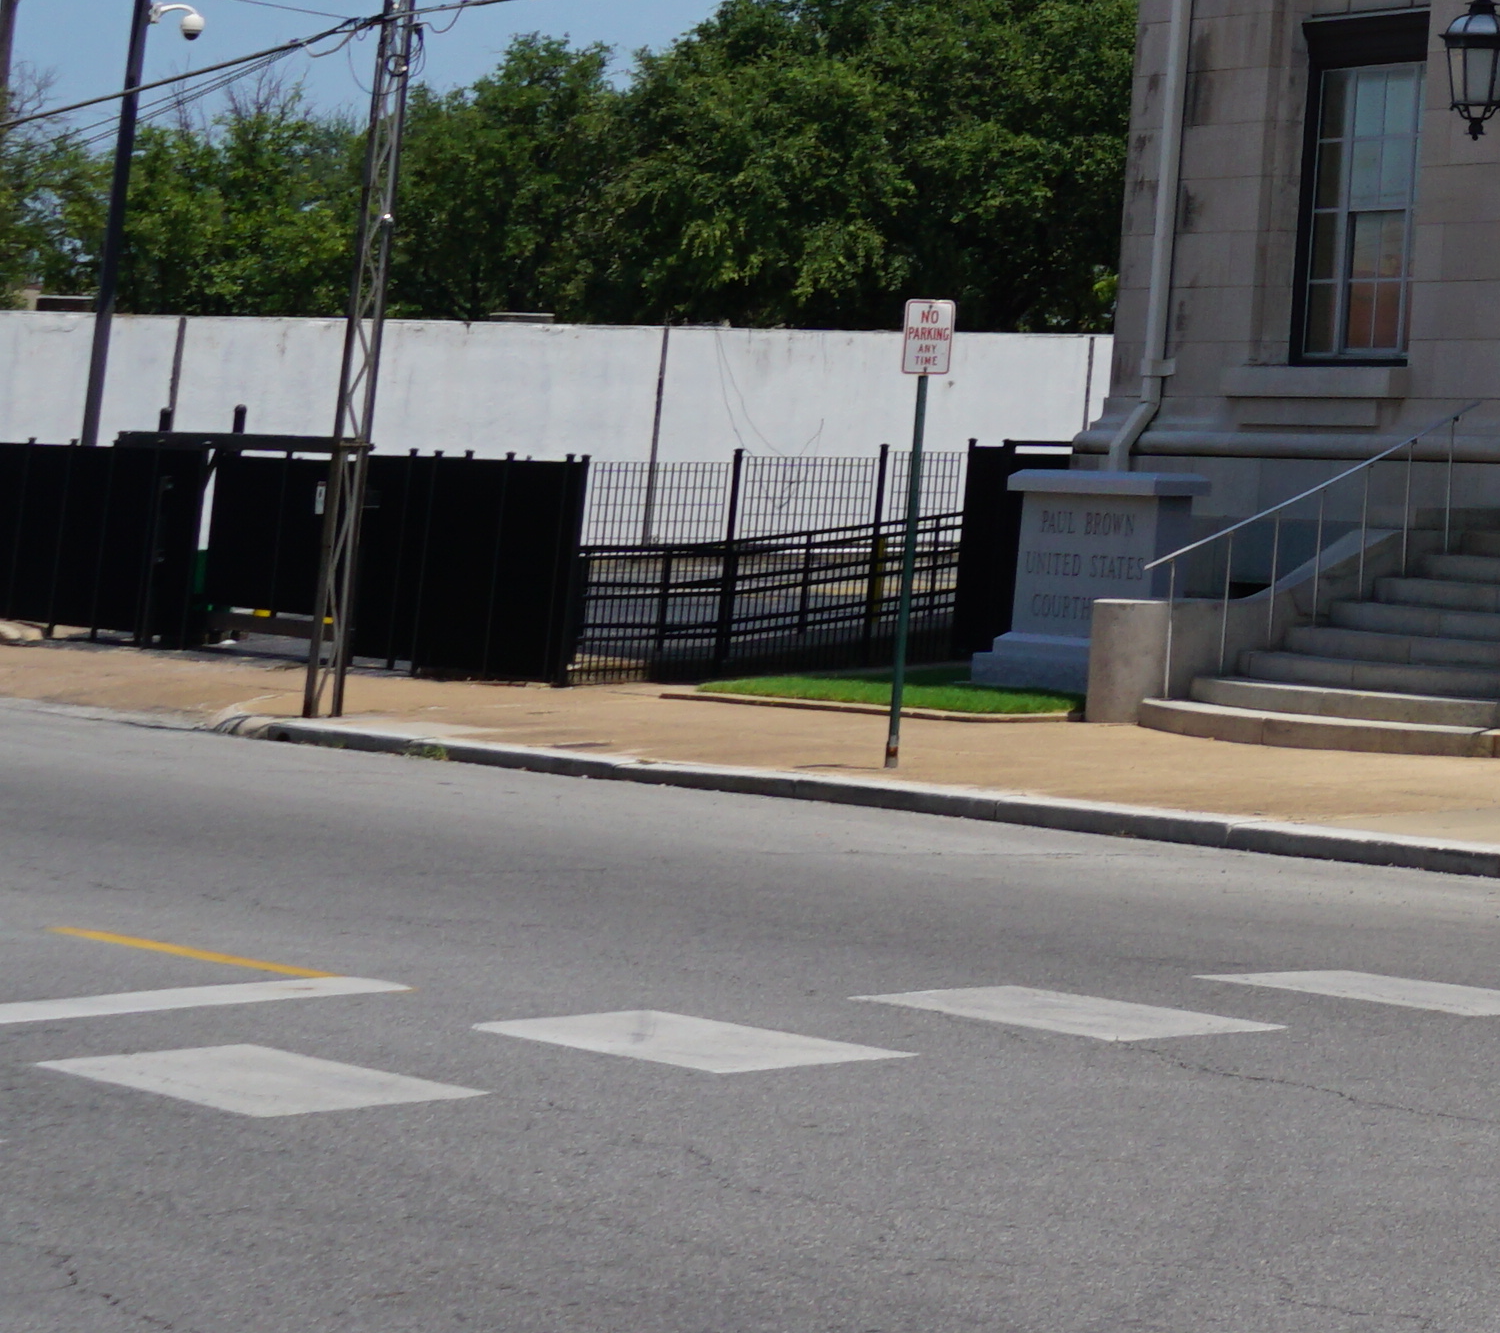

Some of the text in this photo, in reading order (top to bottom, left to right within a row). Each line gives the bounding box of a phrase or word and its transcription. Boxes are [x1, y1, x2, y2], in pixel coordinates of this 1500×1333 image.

[921, 310, 938, 324] NO
[908, 327, 949, 341] PARKING
[917, 344, 936, 353] ANY
[914, 355, 937, 365] TIME
[1040, 510, 1136, 536] PAUL BROWN
[1026, 551, 1145, 581] UNITED STATES
[1031, 593, 1093, 621] COURTH
